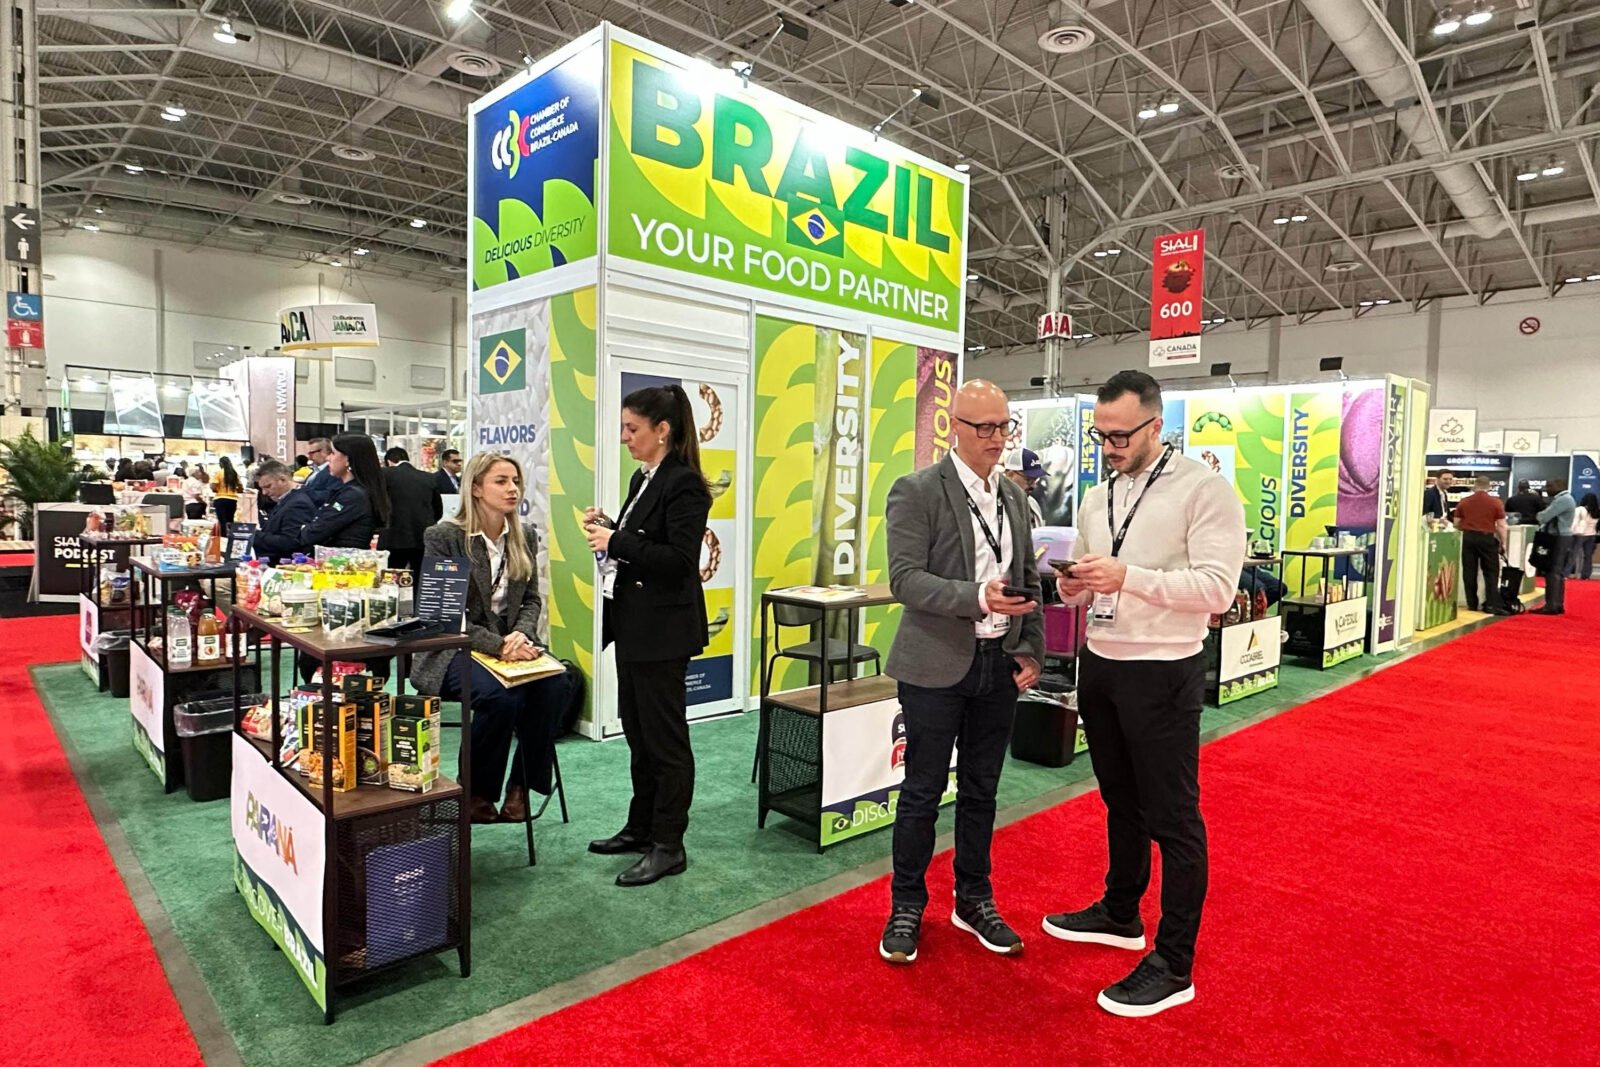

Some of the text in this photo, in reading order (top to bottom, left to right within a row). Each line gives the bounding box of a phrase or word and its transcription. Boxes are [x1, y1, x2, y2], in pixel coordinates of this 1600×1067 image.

[530, 96, 570, 125] CHAMBER OF
[530, 113, 565, 139] COMMERCE
[530, 121, 579, 153] BRAZIL-CANADA
[631, 58, 951, 254] BRAZIL
[485, 216, 586, 263] DELICIOUS DIVERSITY
[631, 213, 949, 321] YOUR FOOD PARTNER
[1042, 314, 1055, 337] A
[1059, 315, 1070, 336] A
[1160, 300, 1193, 319] 600
[331, 320, 367, 332] JAMAICA
[1166, 343, 1197, 353] CANADA
[276, 418, 287, 462] SELECT
[479, 424, 536, 445] FLAVORS
[1081, 408, 1090, 474] BRAZIL
[833, 334, 860, 576] DIVERSITY
[1290, 408, 1309, 518] DIVERSITY
[1384, 395, 1398, 518] DISCOVER
[54, 547, 115, 561] PODCAST
[852, 798, 898, 827] DISCO
[245, 789, 299, 876] PARANÁ
[283, 921, 318, 991] BRAZIL
